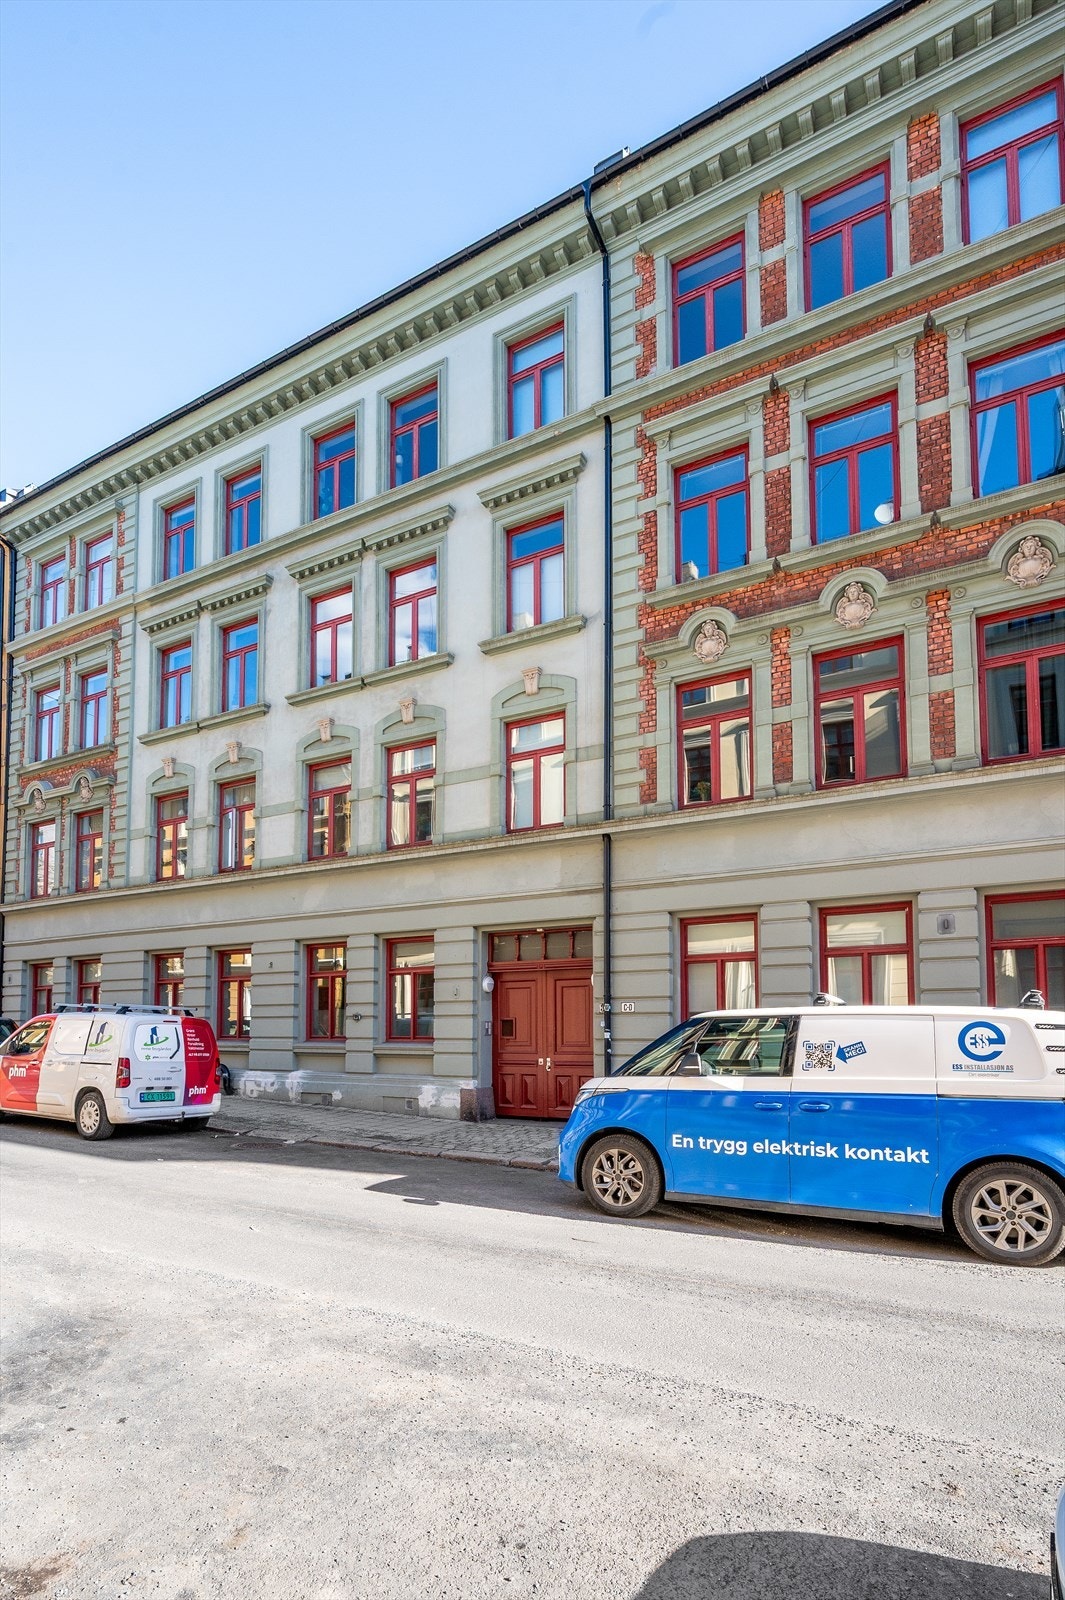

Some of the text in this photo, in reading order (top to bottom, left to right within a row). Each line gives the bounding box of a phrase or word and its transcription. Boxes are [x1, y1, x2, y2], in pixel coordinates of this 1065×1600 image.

[843, 1042, 862, 1052] SKANN
[845, 1046, 865, 1058] MEG!
[8, 1063, 27, 1080] phm
[188, 1085, 207, 1098] phm
[671, 1133, 930, 1164] En trygg elektrisk kontakt
